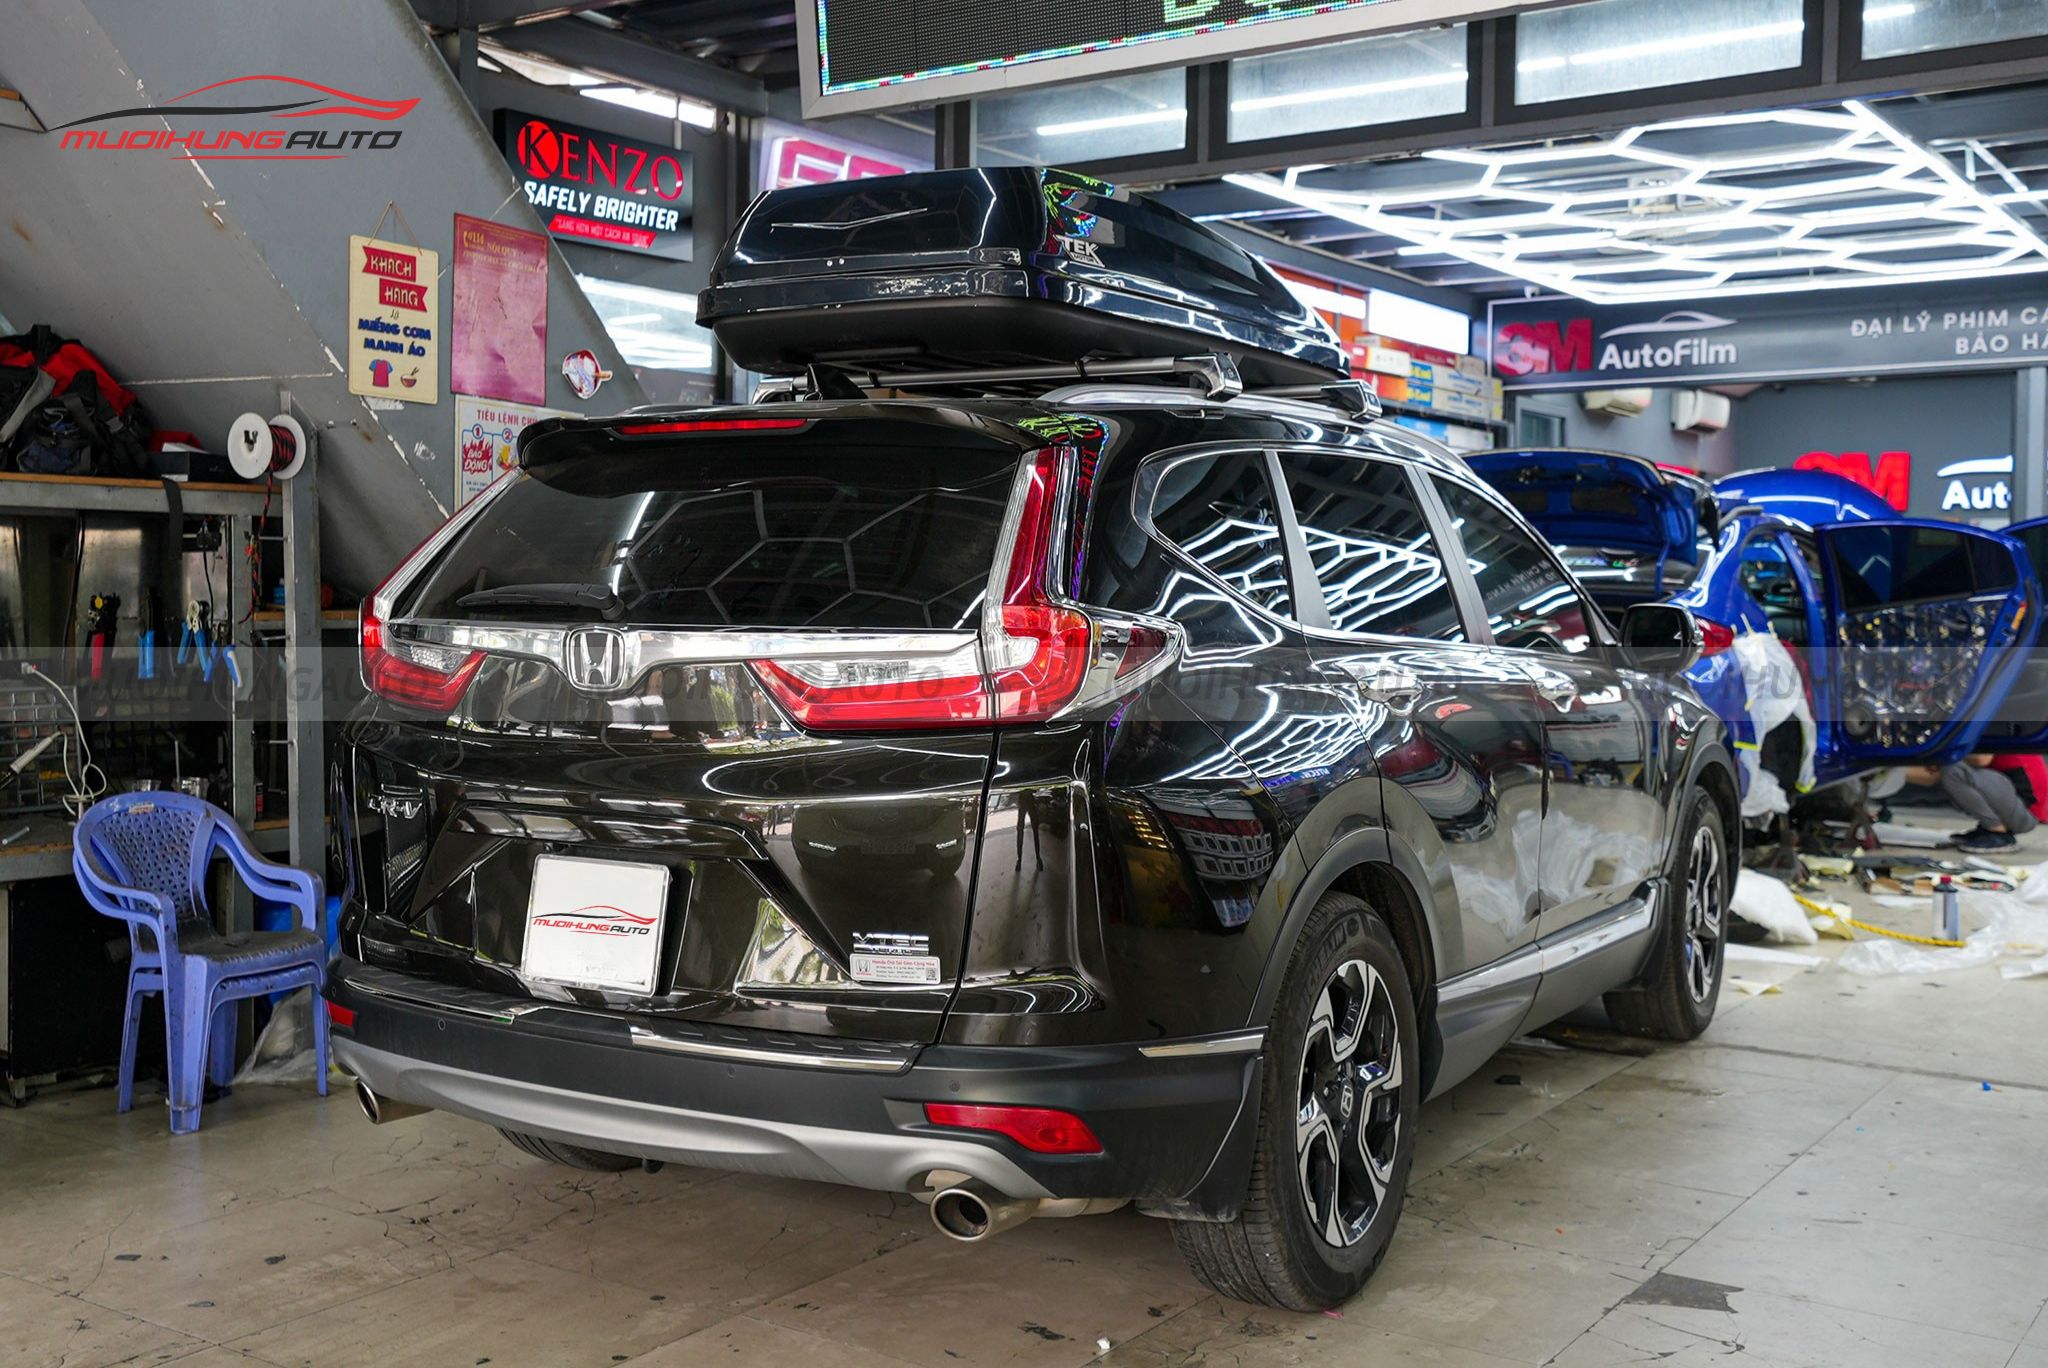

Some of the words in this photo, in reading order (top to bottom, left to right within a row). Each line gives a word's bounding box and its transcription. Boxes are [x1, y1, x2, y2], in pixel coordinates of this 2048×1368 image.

[517, 120, 684, 201] KENZO
[524, 181, 591, 213] SAFELY
[594, 195, 680, 231] BRIGHTER
[1056, 236, 1102, 260] TEK
[1851, 316, 1893, 339] ĐẠI
[1943, 309, 2009, 331] PHIM
[1494, 318, 1594, 377] 3M
[1599, 337, 1738, 371] AutoFilm
[1955, 330, 2009, 355] BẢO
[1942, 480, 2011, 510] Aut
[852, 932, 929, 948] VTEC
